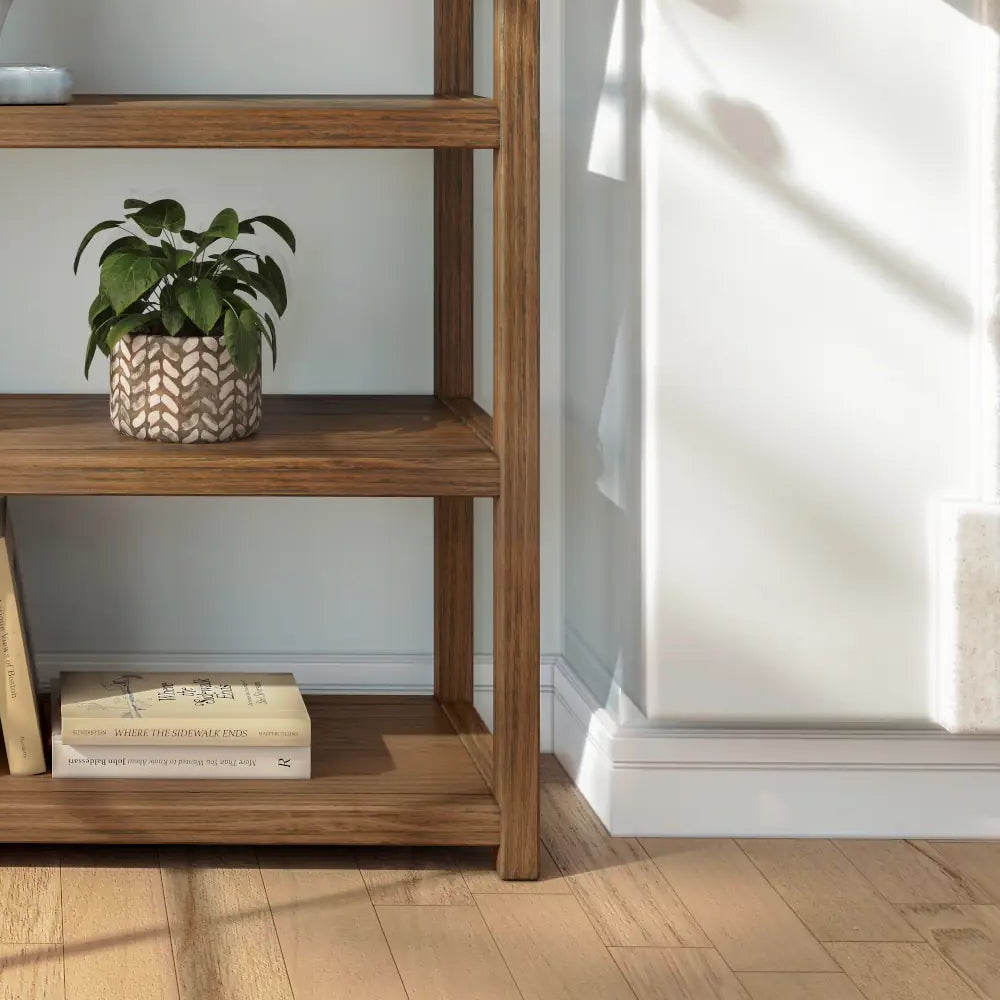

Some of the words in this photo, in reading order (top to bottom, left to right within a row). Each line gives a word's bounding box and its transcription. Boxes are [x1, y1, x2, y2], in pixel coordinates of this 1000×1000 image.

[0, 631, 11, 658] Views
[7, 669, 17, 699] Boston
[114, 728, 150, 737] WHERE
[151, 728, 171, 737] THE
[171, 728, 221, 738] SIDEWALK
[222, 728, 248, 738] ENDS
[67, 757, 106, 766] Baldessari
[108, 757, 126, 766] John
[150, 758, 168, 766] Know
[178, 758, 204, 767] Wanted
[205, 759, 218, 767] You
[220, 759, 237, 767] Than
[238, 759, 257, 767] More
[277, 757, 291, 768] R
